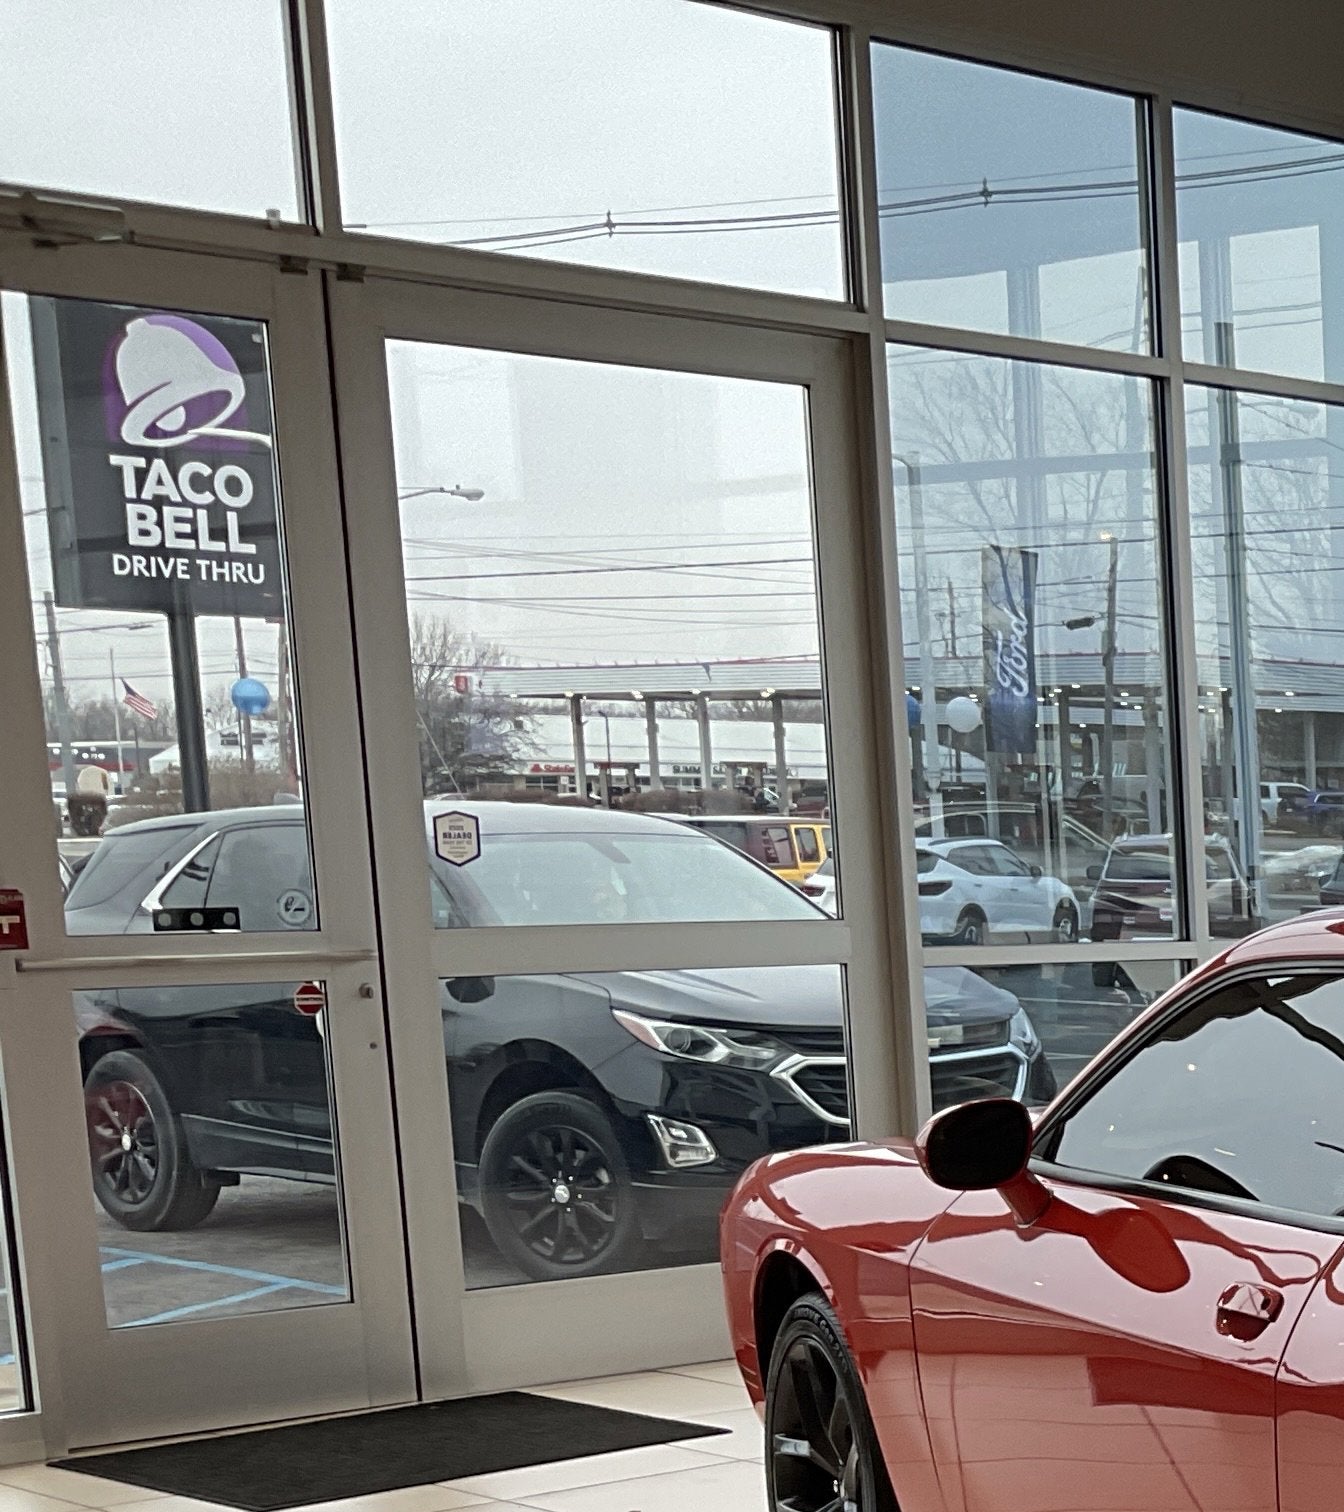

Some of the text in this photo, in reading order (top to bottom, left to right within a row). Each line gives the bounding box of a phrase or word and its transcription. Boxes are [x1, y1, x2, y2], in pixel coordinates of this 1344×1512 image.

[109, 454, 254, 508] TACO
[126, 503, 257, 555] BELL
[112, 553, 265, 585] DRIVE THRU
[995, 607, 1029, 697] Ford
